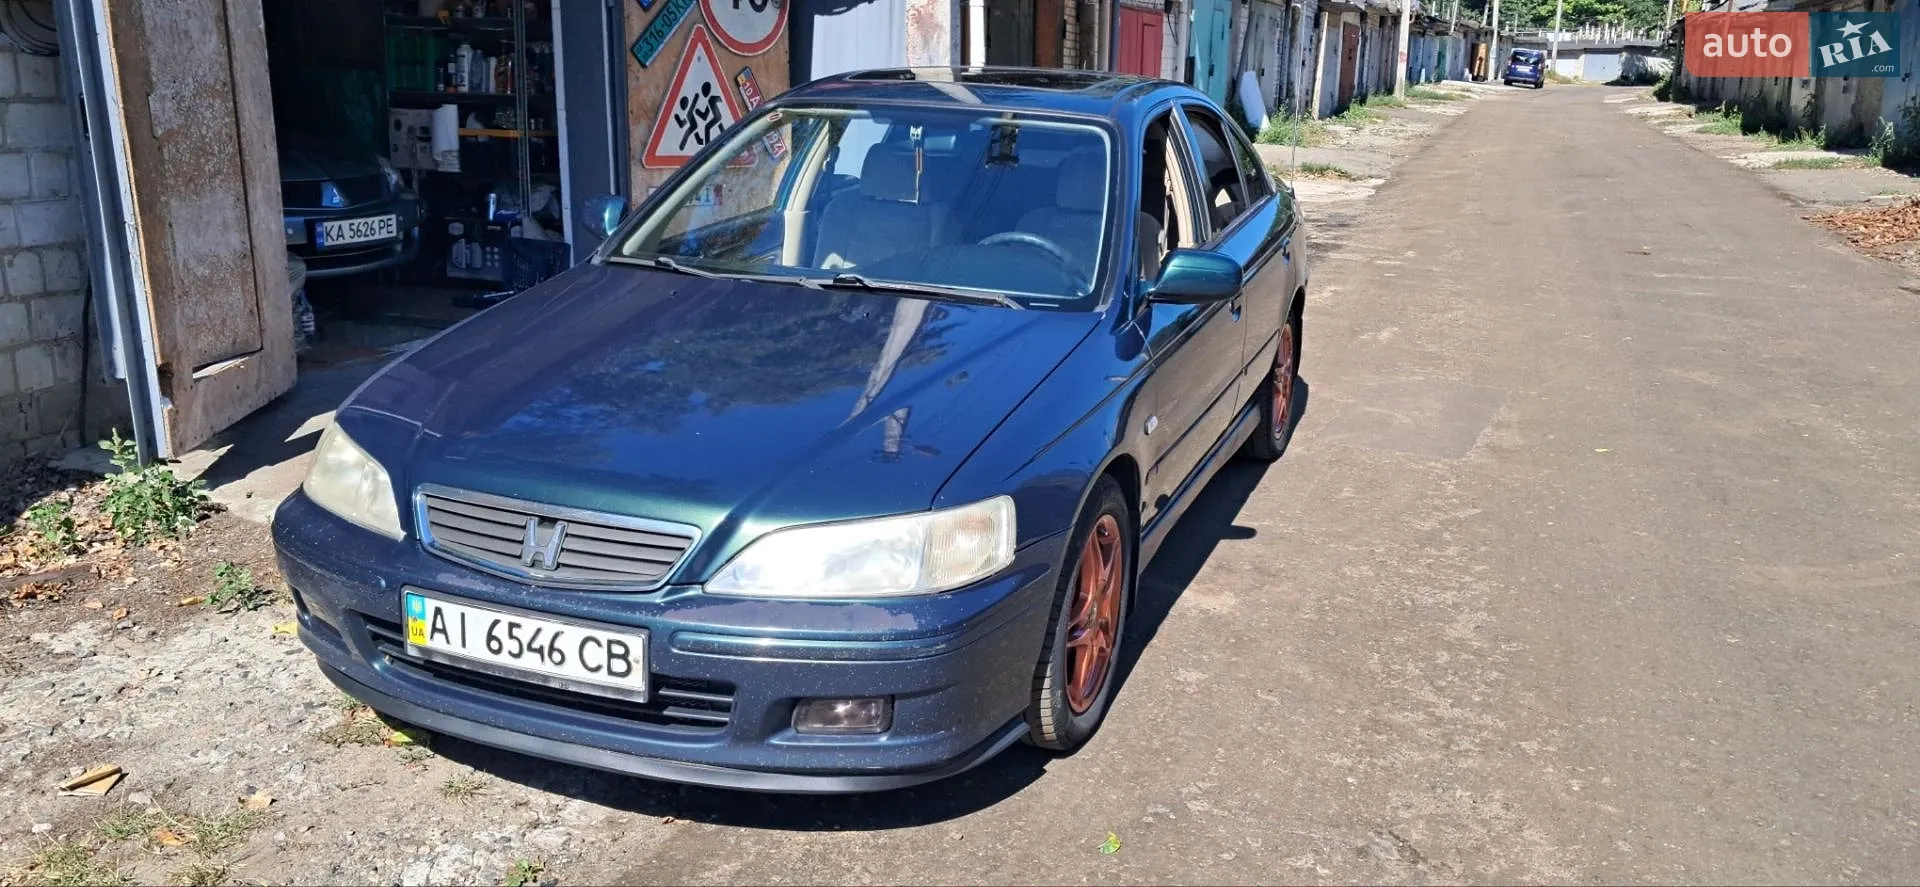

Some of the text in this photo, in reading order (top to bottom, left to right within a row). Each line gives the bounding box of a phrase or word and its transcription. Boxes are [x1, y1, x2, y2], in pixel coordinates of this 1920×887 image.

[325, 224, 345, 242] KA
[348, 220, 376, 239] 5626
[378, 218, 393, 235] PE
[411, 625, 425, 638] UA
[430, 606, 633, 678] AI 6546 CB
